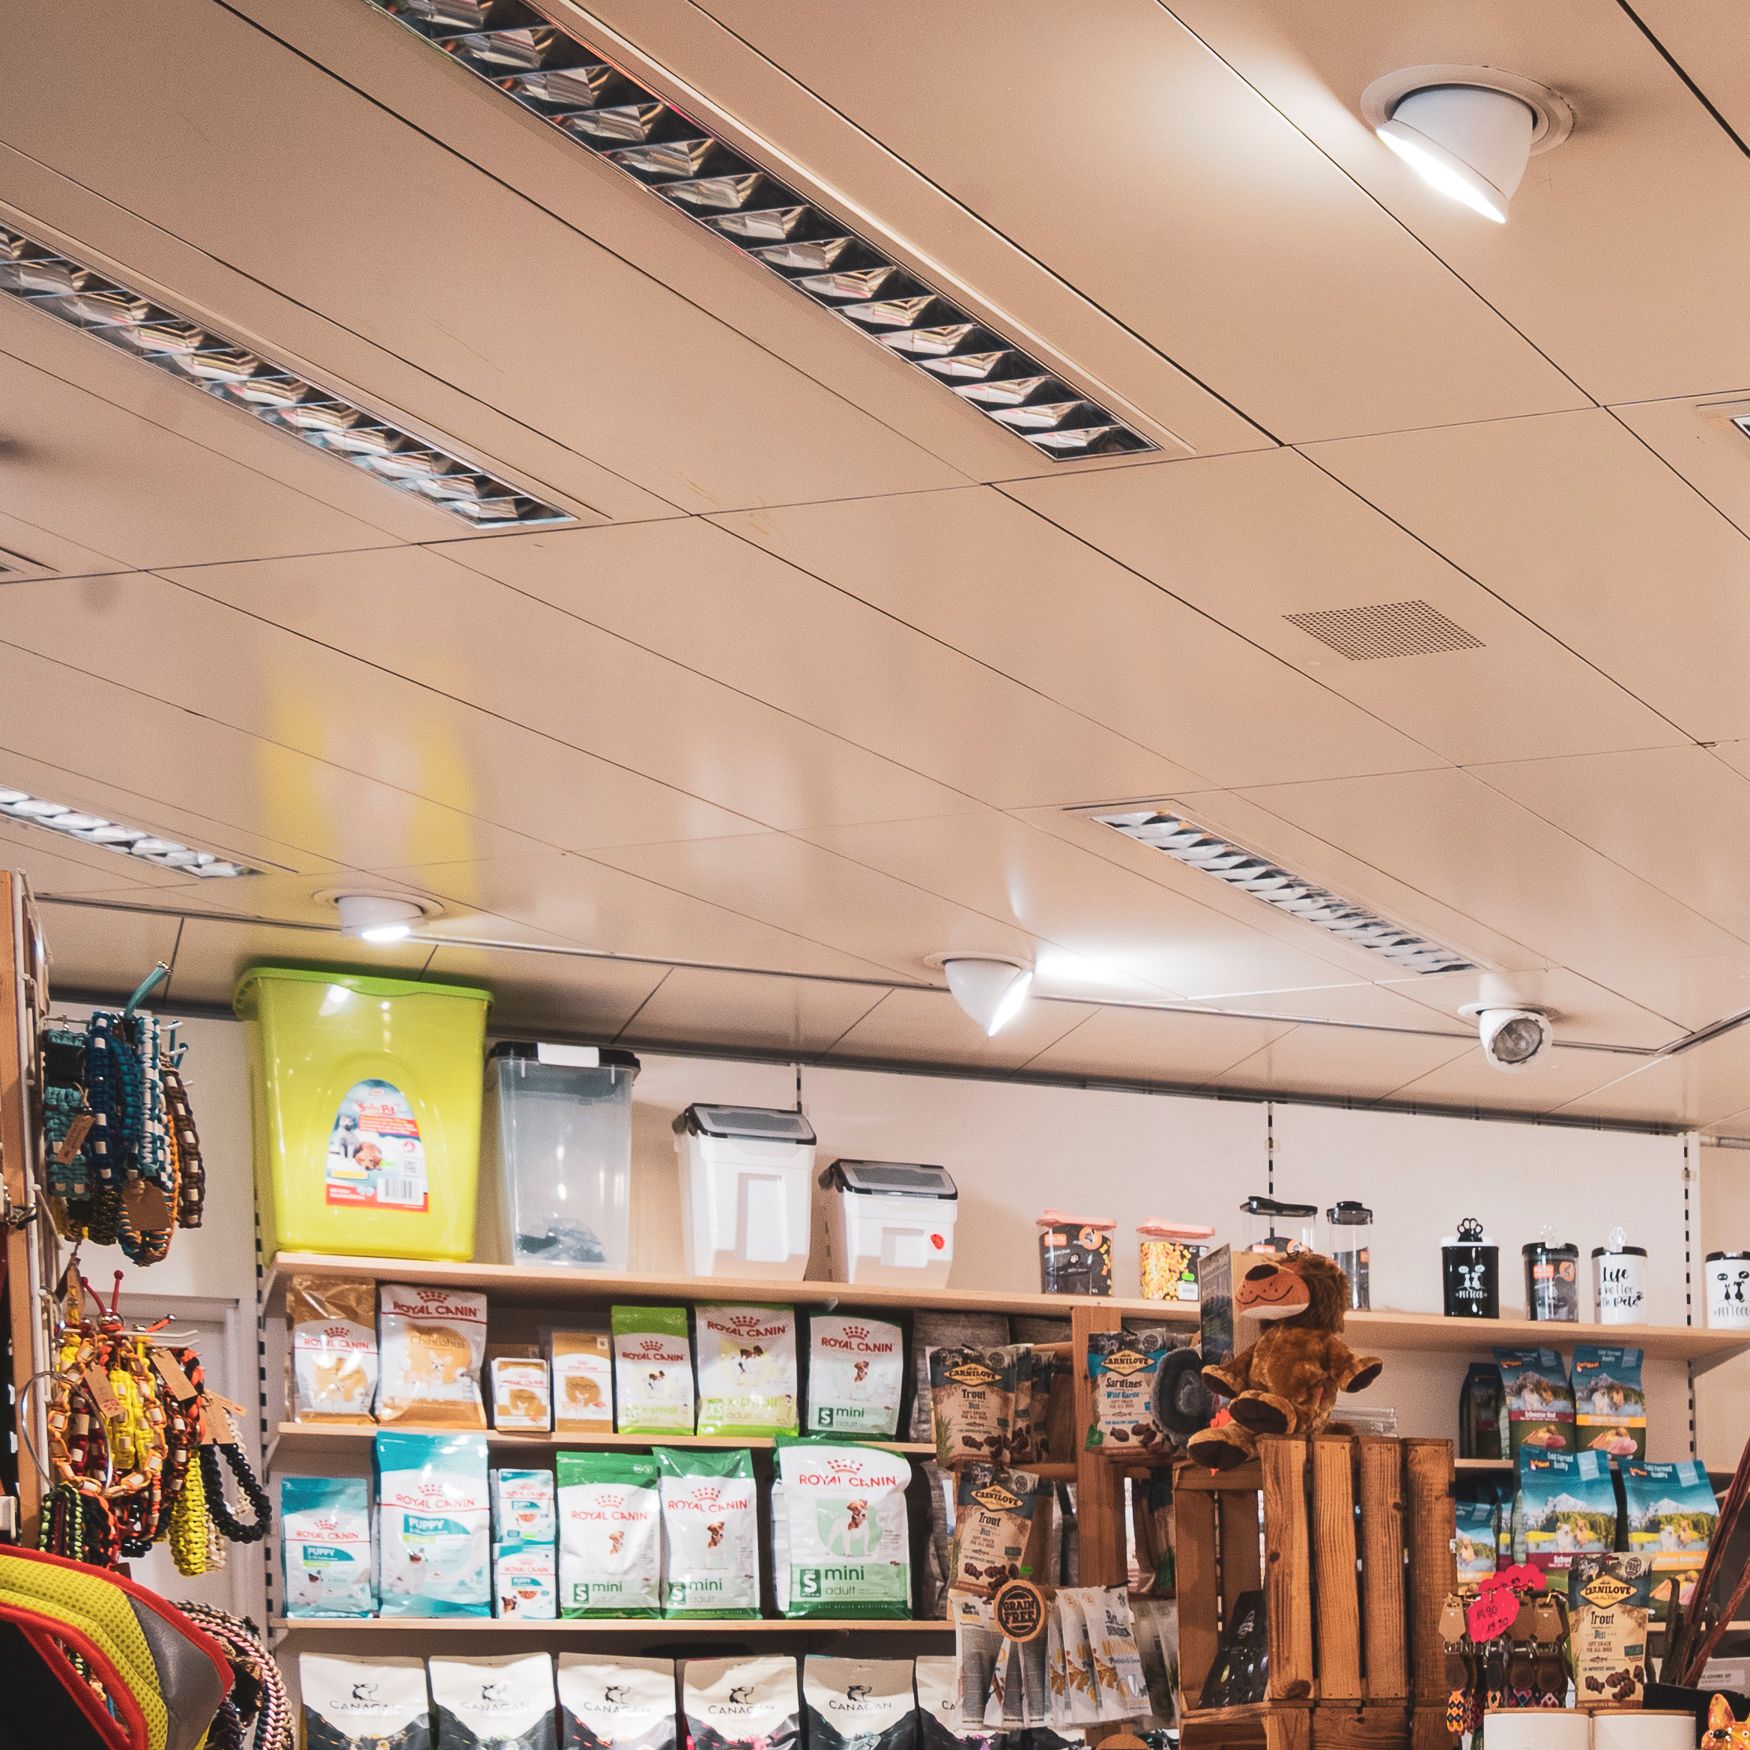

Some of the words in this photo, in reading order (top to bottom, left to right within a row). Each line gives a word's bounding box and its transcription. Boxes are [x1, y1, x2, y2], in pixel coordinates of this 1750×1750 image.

[706, 1320, 745, 1338] ROYAL
[746, 1323, 787, 1338] CANIN
[820, 1336, 856, 1351] ROYAL
[857, 1340, 893, 1353] CANIN
[836, 1407, 865, 1418] mini
[408, 1516, 446, 1530] PUPPY
[824, 1565, 865, 1581] mini
[824, 1585, 857, 1597] adult
[1584, 1584, 1632, 1596] CARNILOVE
[1002, 1600, 1035, 1613] GRAIN
[1003, 1610, 1035, 1626] FREE
[1590, 1612, 1615, 1626] Trout
